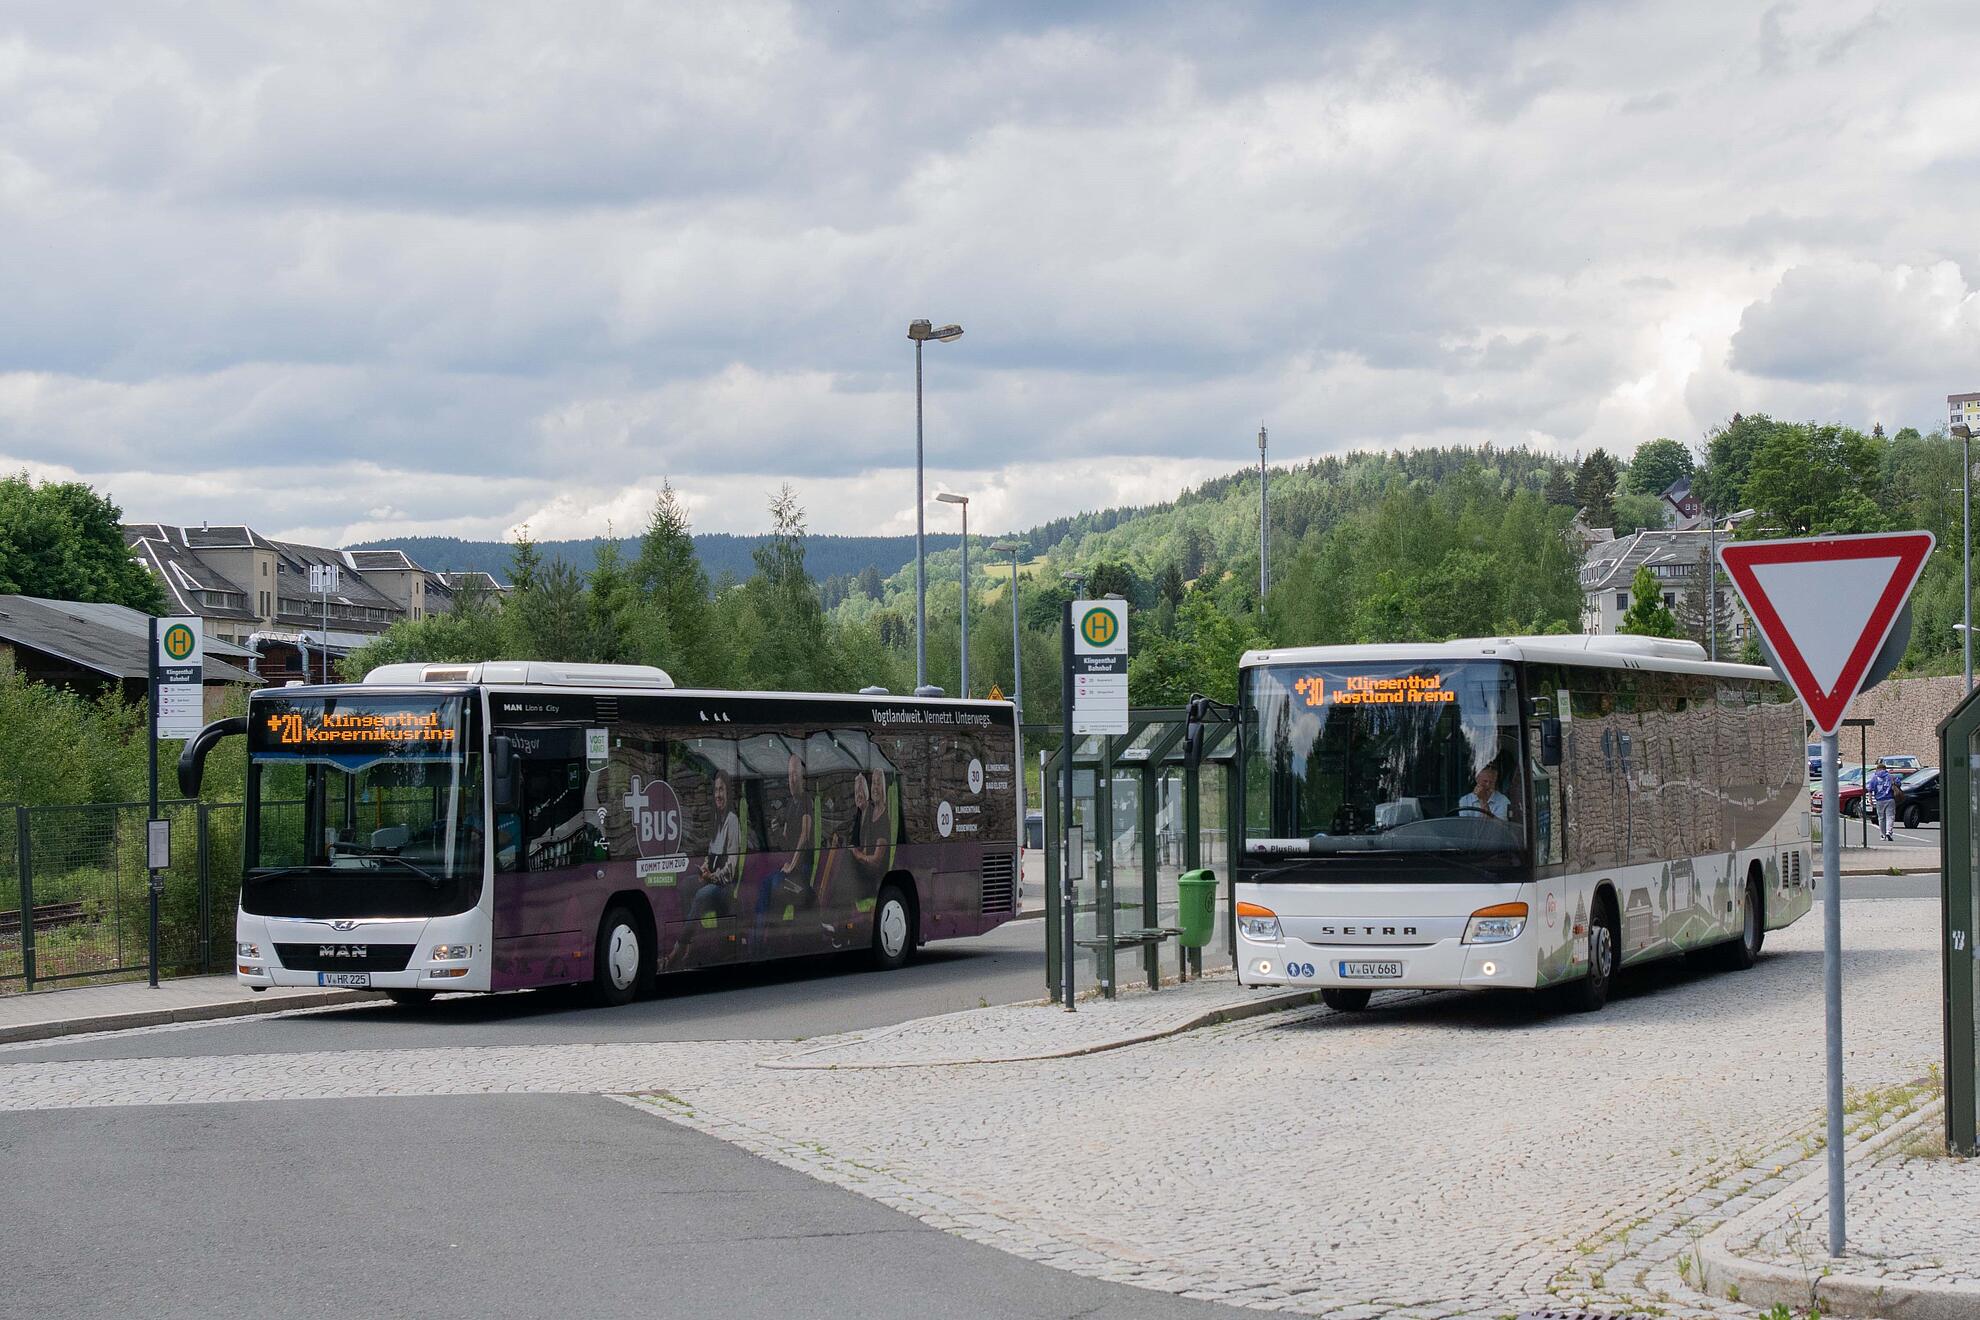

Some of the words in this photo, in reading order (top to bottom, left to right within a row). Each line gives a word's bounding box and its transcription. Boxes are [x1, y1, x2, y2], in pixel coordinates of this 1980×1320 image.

[1092, 616, 1107, 639] H
[173, 631, 186, 653] H
[1084, 657, 1116, 667] Klingenthal
[166, 669, 193, 677] Klingenthal
[1347, 675, 1440, 690] Klingenthal
[1332, 690, 1404, 703] Vogtland
[1407, 690, 1455, 702] Arena
[504, 703, 523, 711] MAN
[525, 704, 543, 712] Lion's
[545, 705, 560, 713] City
[323, 712, 438, 727] Klingenthal
[872, 708, 923, 726] Vogtlandweit.
[923, 710, 955, 724] Vernetzt.
[955, 711, 993, 728] Unterwegs.
[306, 727, 455, 741] Kopernikusring
[971, 770, 980, 782] 30
[941, 813, 950, 826] 20
[641, 861, 661, 873] KOMMT
[661, 859, 674, 870] ZUM
[674, 858, 687, 868] ZUG
[1322, 926, 1417, 936] SETRA
[319, 945, 367, 958] MAN
